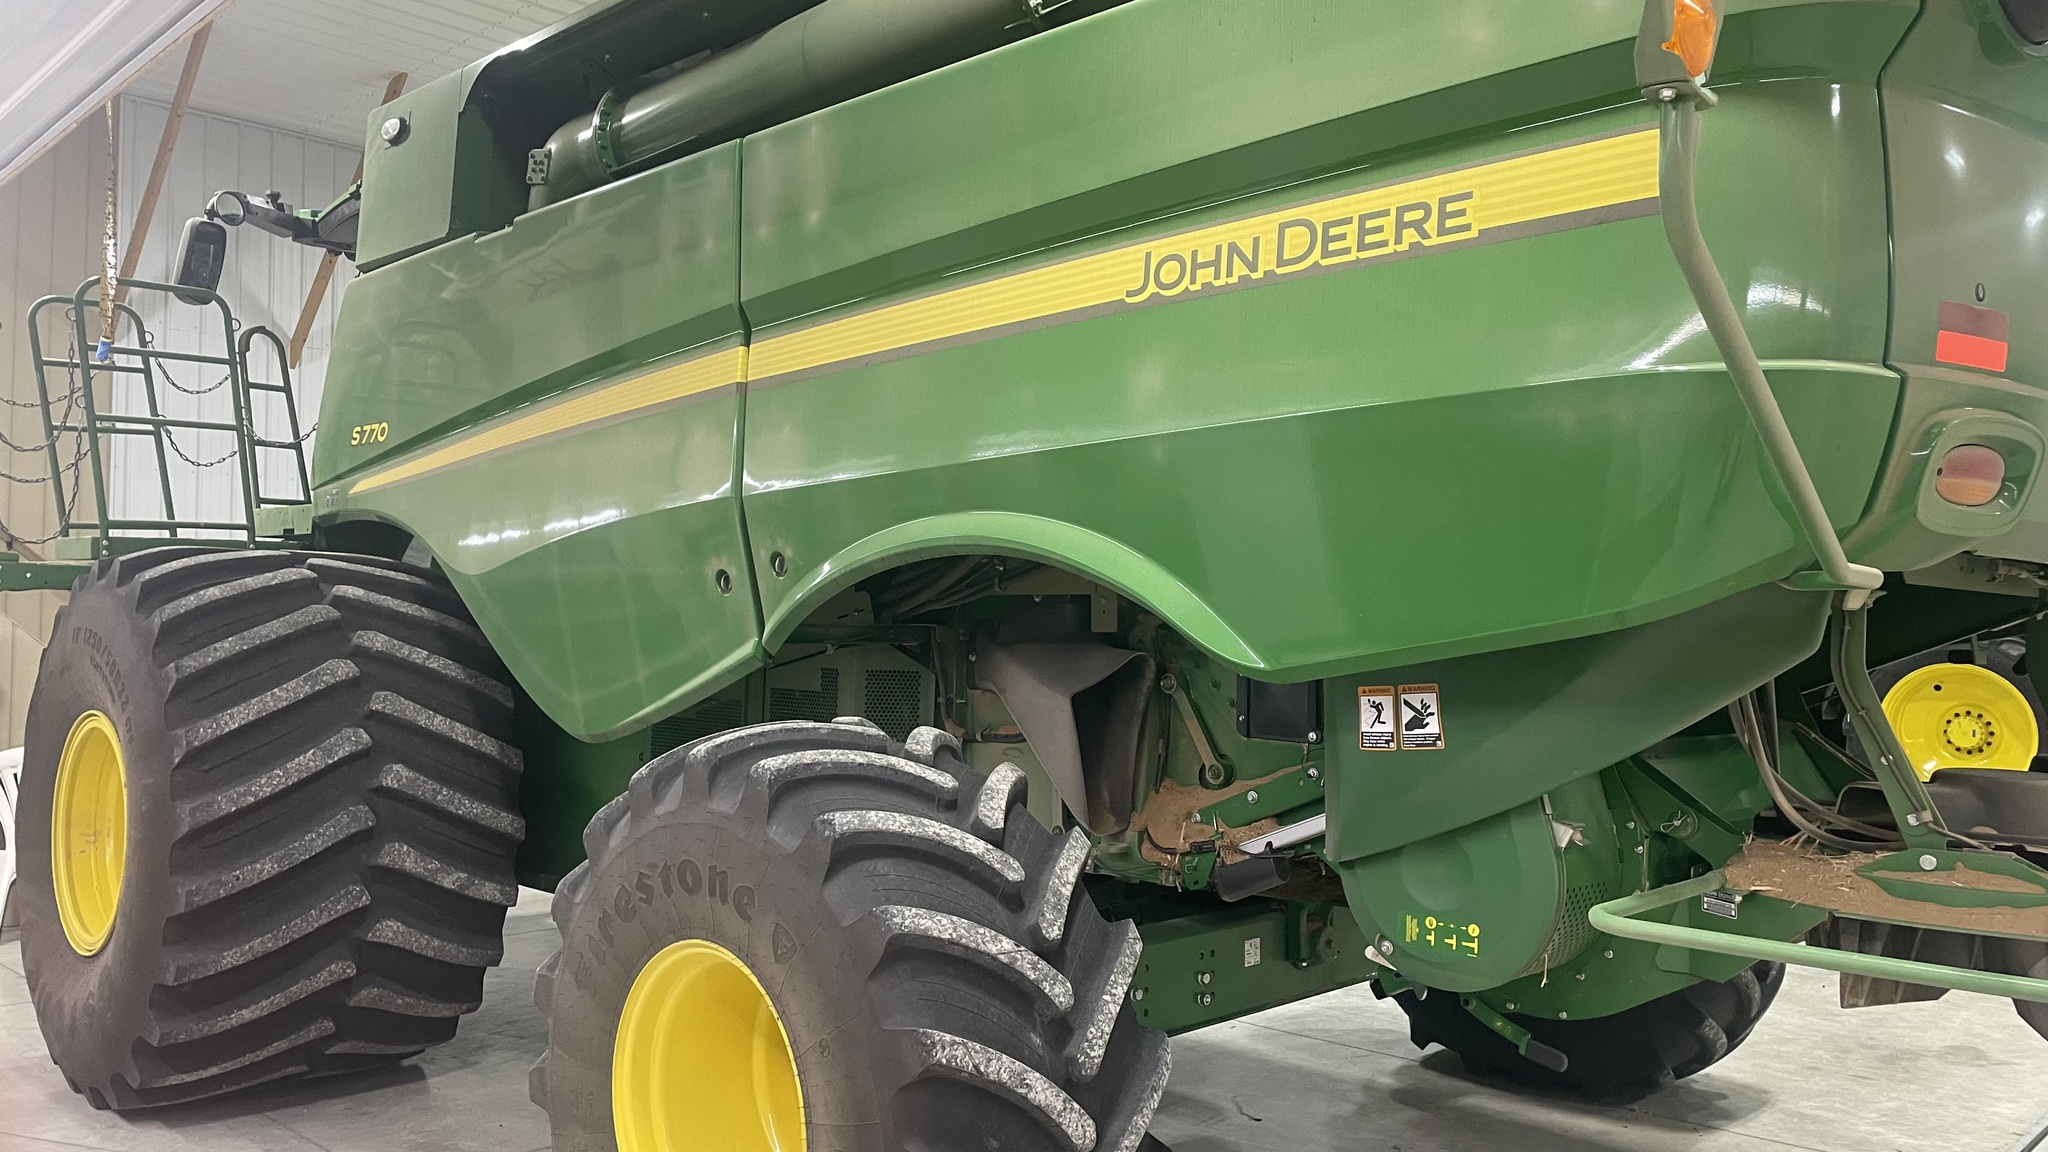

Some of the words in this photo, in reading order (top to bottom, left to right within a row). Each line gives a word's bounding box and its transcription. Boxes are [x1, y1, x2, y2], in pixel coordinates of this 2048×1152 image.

[1125, 235, 1261, 298] JOHN
[1275, 190, 1474, 269] DEERE
[350, 421, 389, 446] S770
